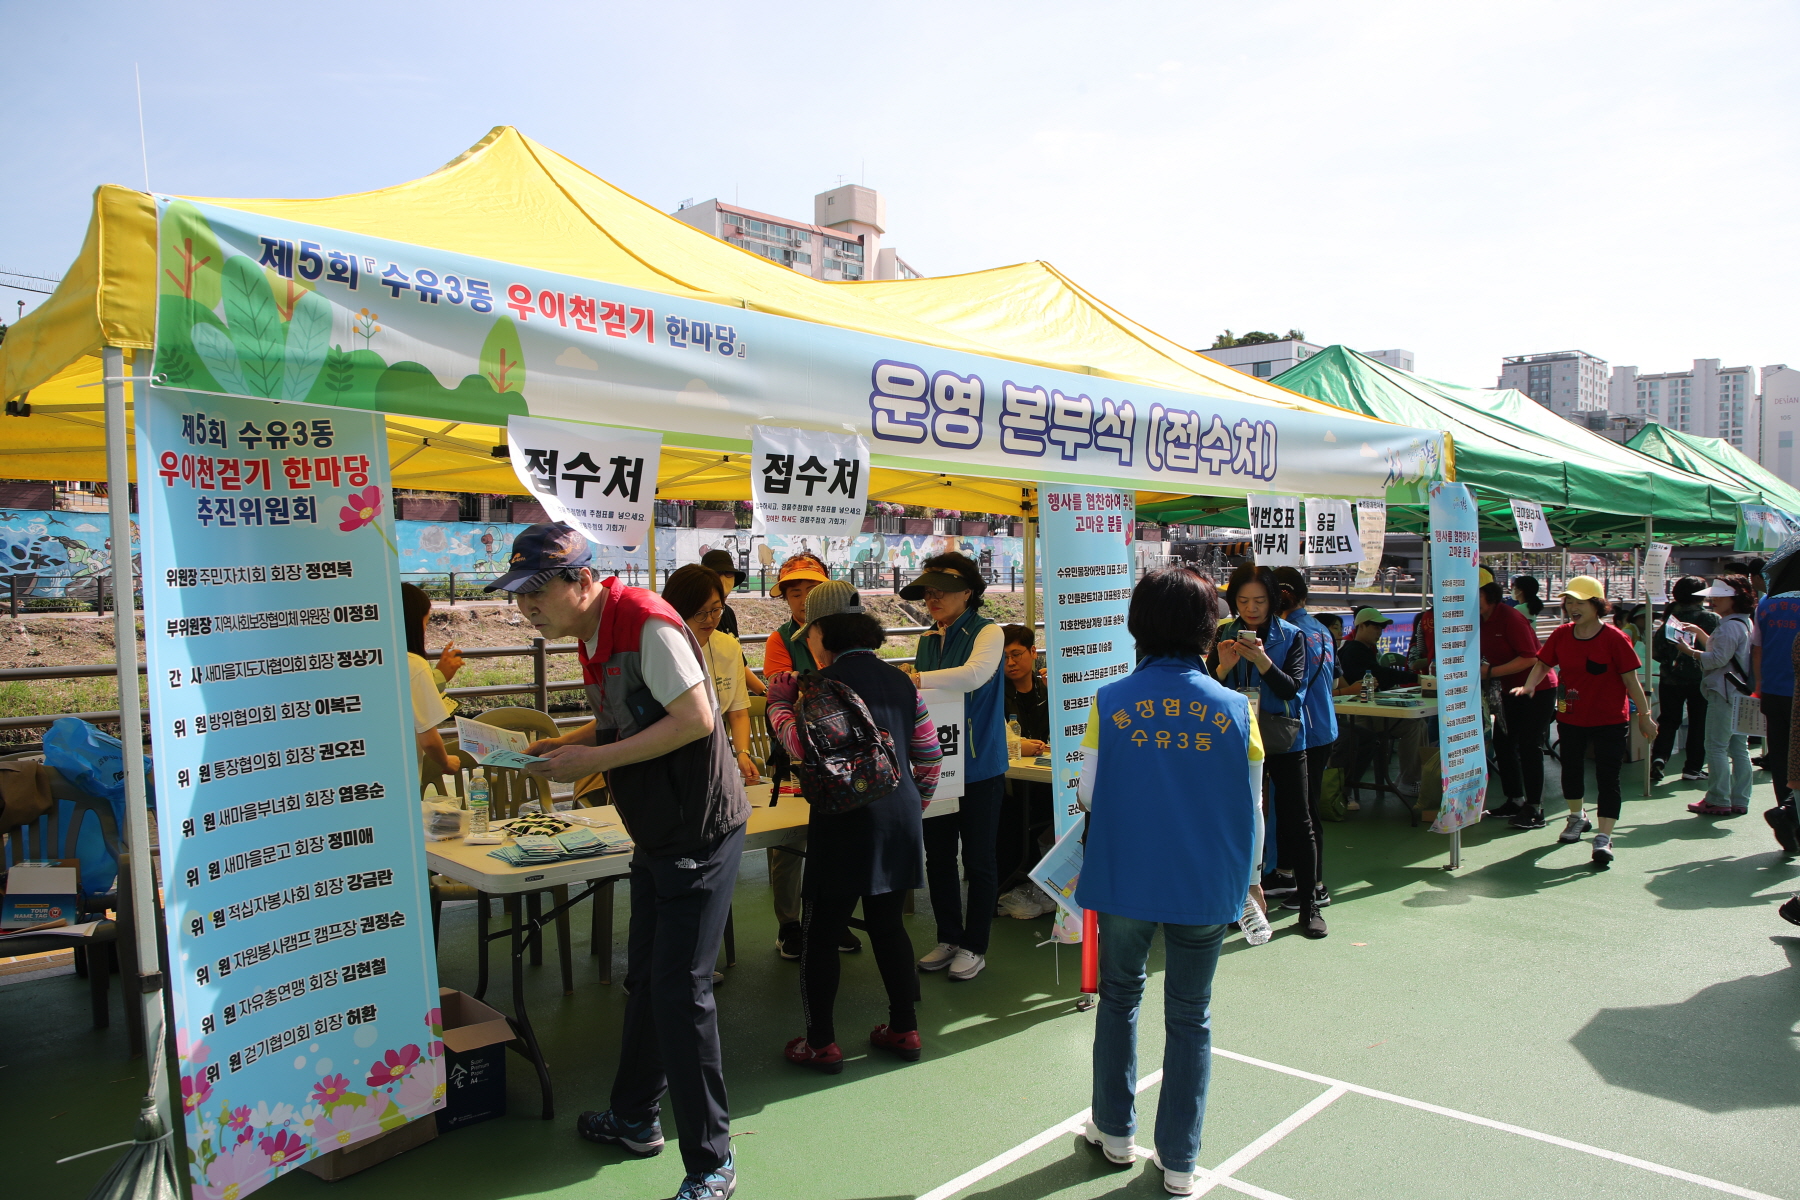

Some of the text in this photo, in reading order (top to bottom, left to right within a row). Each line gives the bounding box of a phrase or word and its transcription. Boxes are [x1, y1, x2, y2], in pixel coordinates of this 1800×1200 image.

[258, 236, 359, 291] 제5회
[506, 283, 656, 344] 우이천걷기
[181, 413, 335, 450] 제5회 수유3동
[869, 358, 1278, 482] 운영 본부석 (접수처)
[158, 451, 371, 491] 우이천걷기 한마당
[524, 448, 644, 503] 접수처
[762, 453, 860, 499] 접수처
[197, 495, 318, 527] 추진위원회
[1047, 492, 1133, 512] 행사를 협찬하여 주신
[1514, 506, 1541, 521] 코마일리지
[1075, 515, 1122, 533] 고마운 분들
[1317, 512, 1336, 532] 응급
[1308, 535, 1353, 554] 진료센터
[166, 560, 353, 587] 위원장 주민자치회 회장 정연복
[1106, 564, 1116, 575] 대표
[166, 603, 379, 637] 부위원장 지역사회보장협의체 위원장 이정희
[1102, 615, 1112, 627] 대표
[204, 655, 307, 683] 새마을지도자협의회
[308, 653, 335, 671] 회장
[336, 648, 383, 668] 정상기
[1061, 645, 1085, 657] 7번약국
[1086, 643, 1098, 655] 대표
[1062, 671, 1083, 684] 하바나
[1083, 667, 1108, 681] 스크린골프
[1109, 665, 1117, 676] 대표
[209, 705, 277, 731] 방위협의회
[280, 700, 312, 720] 회장
[314, 695, 362, 716] 이복근
[1063, 697, 1089, 711] 탱크호프
[1111, 698, 1232, 734] 통장협의회
[1131, 729, 1212, 751] 수유3동
[213, 750, 281, 780] 통장협의회
[285, 746, 316, 766] 회장
[318, 739, 366, 762] 권오진
[218, 795, 301, 828] 새마을부녀회
[304, 789, 335, 809] 회장
[338, 782, 385, 804] 염용순
[223, 843, 291, 875] 새마을문고
[295, 836, 325, 856] 회장
[327, 827, 374, 850] 정미애
[228, 885, 310, 922] 적십자봉사회
[313, 877, 344, 899] 회장
[347, 868, 393, 892] 강금란
[233, 930, 312, 970] 자원봉사캠프
[314, 920, 358, 945] 캠프장
[359, 910, 406, 934] 권정순
[238, 976, 306, 1019] 자유총연맹
[308, 969, 339, 993] 회장
[341, 957, 387, 983] 김현철
[244, 1023, 311, 1065] 걷기협의회
[314, 1012, 343, 1037] 회장
[346, 1004, 377, 1027] 허환
[470, 1077, 478, 1085] A4
